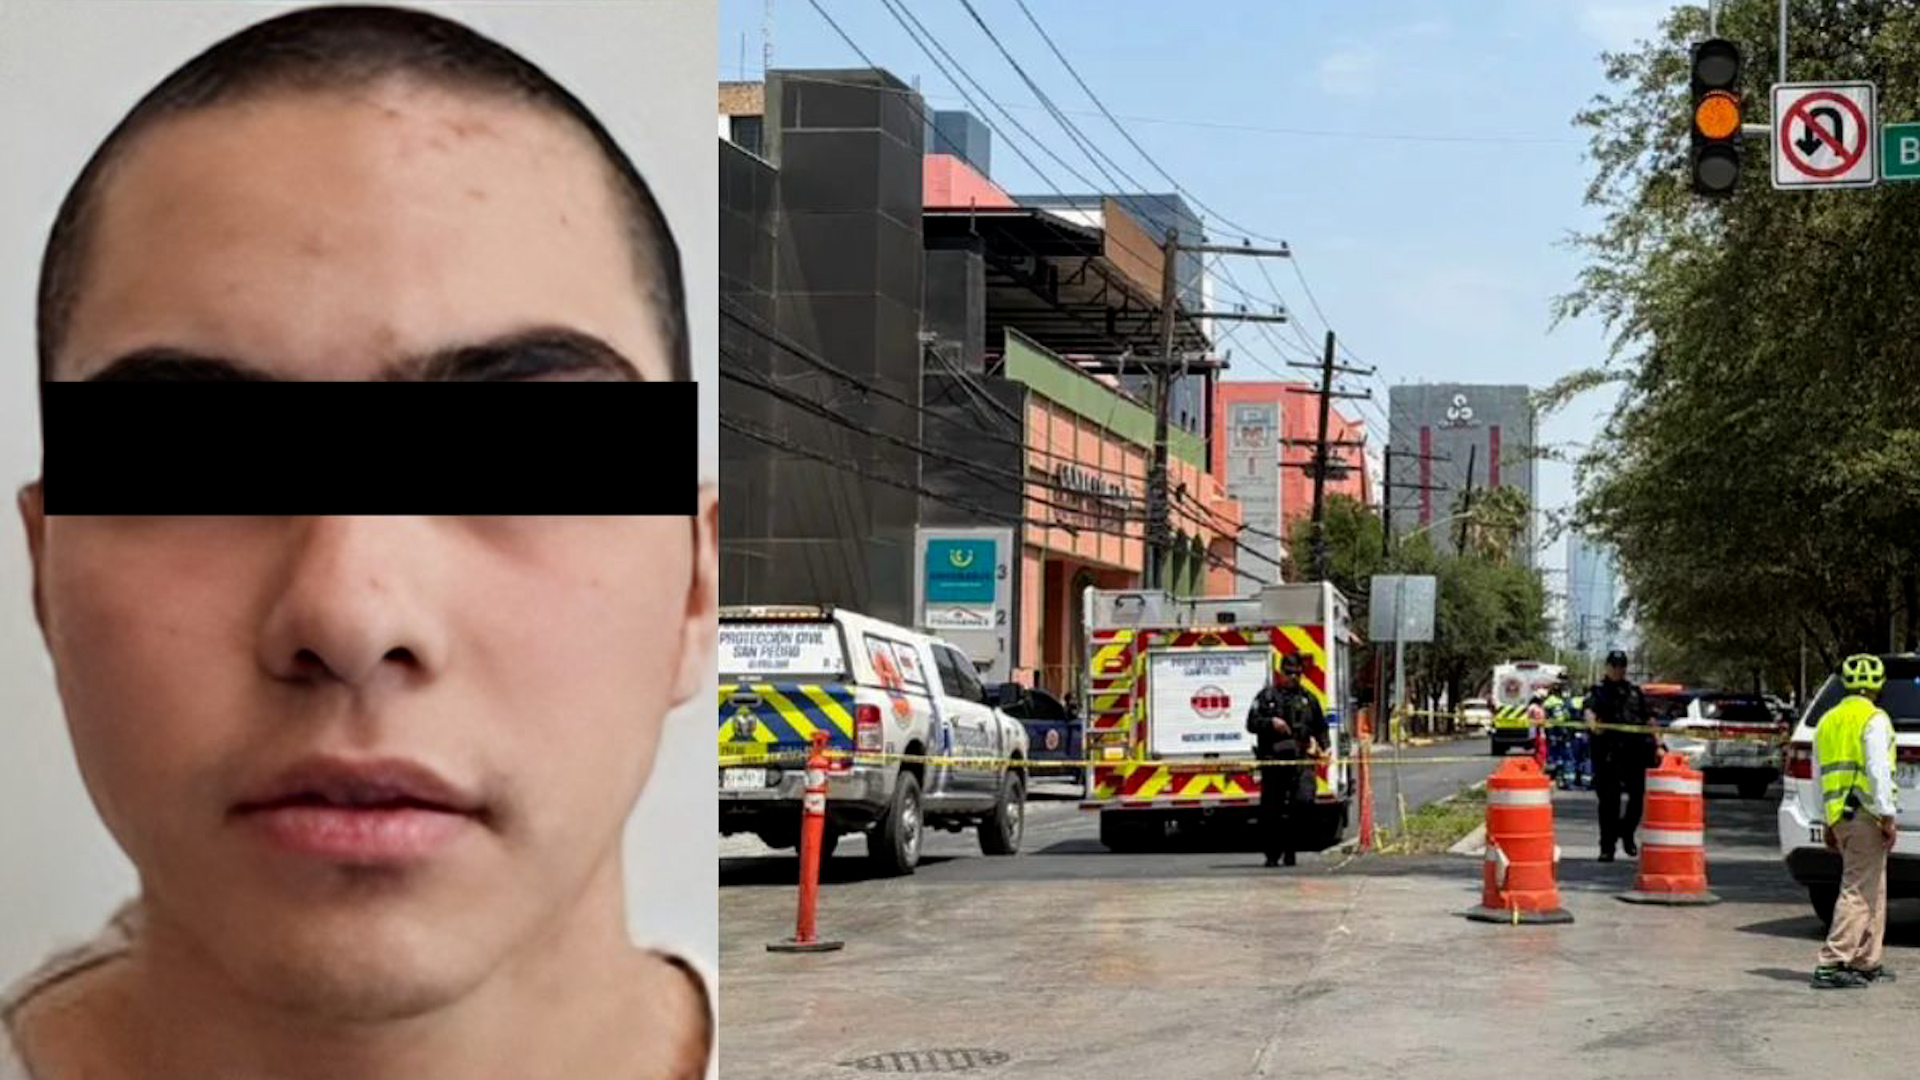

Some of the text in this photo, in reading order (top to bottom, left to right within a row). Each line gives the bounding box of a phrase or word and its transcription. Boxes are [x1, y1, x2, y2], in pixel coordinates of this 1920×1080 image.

[997, 565, 1007, 579] 3
[996, 611, 1006, 625] 2
[795, 631, 824, 645] CIVIL
[998, 638, 1004, 651] 1
[733, 645, 801, 658] SAN PEDRO
